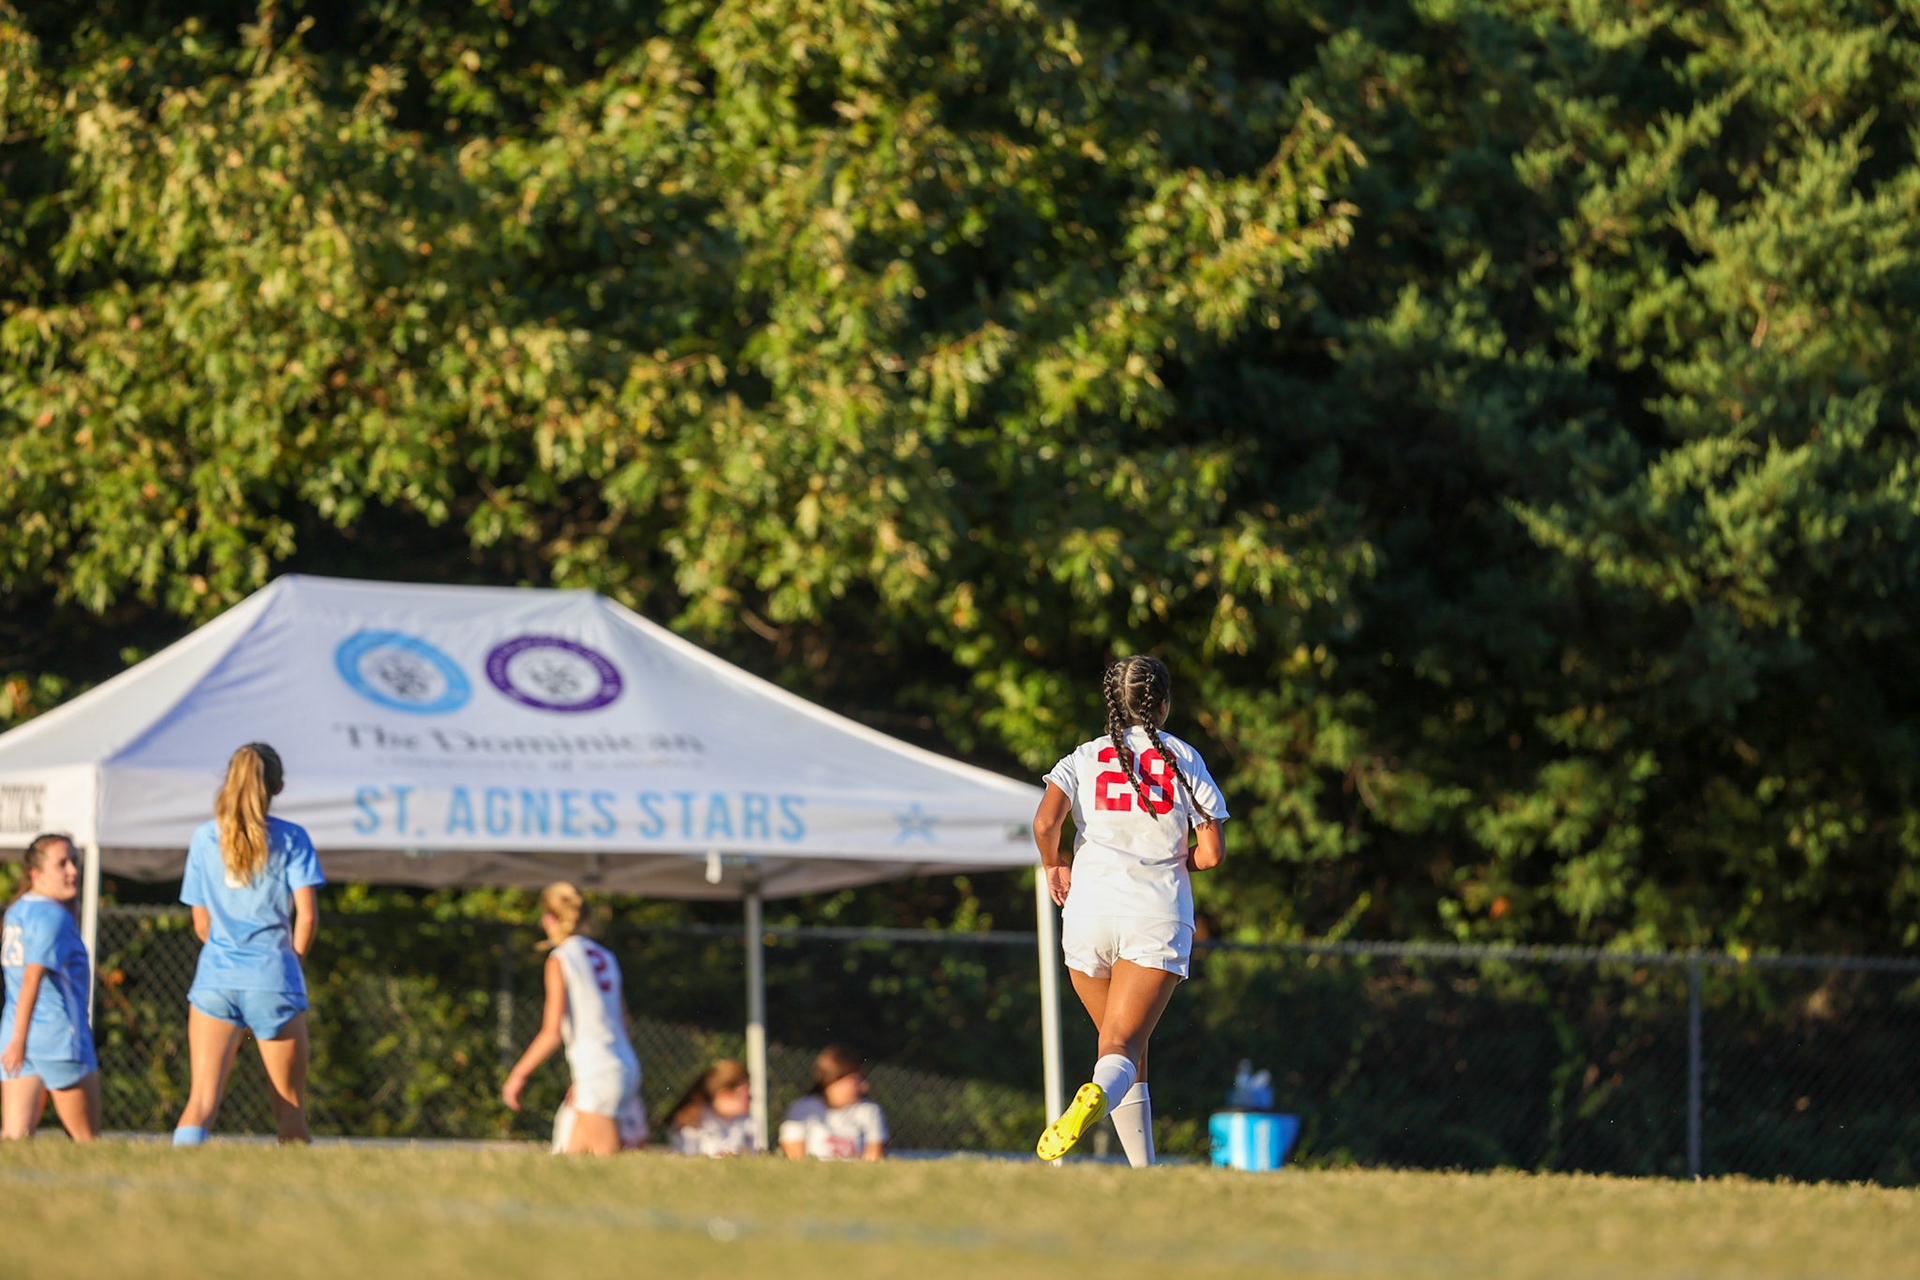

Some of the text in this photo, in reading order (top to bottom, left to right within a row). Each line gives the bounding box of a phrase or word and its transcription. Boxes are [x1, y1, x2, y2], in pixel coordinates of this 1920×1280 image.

[333, 723, 706, 755] The Dominican
[1095, 746, 1176, 814] 28
[354, 785, 806, 842] ST. AGNES STARS
